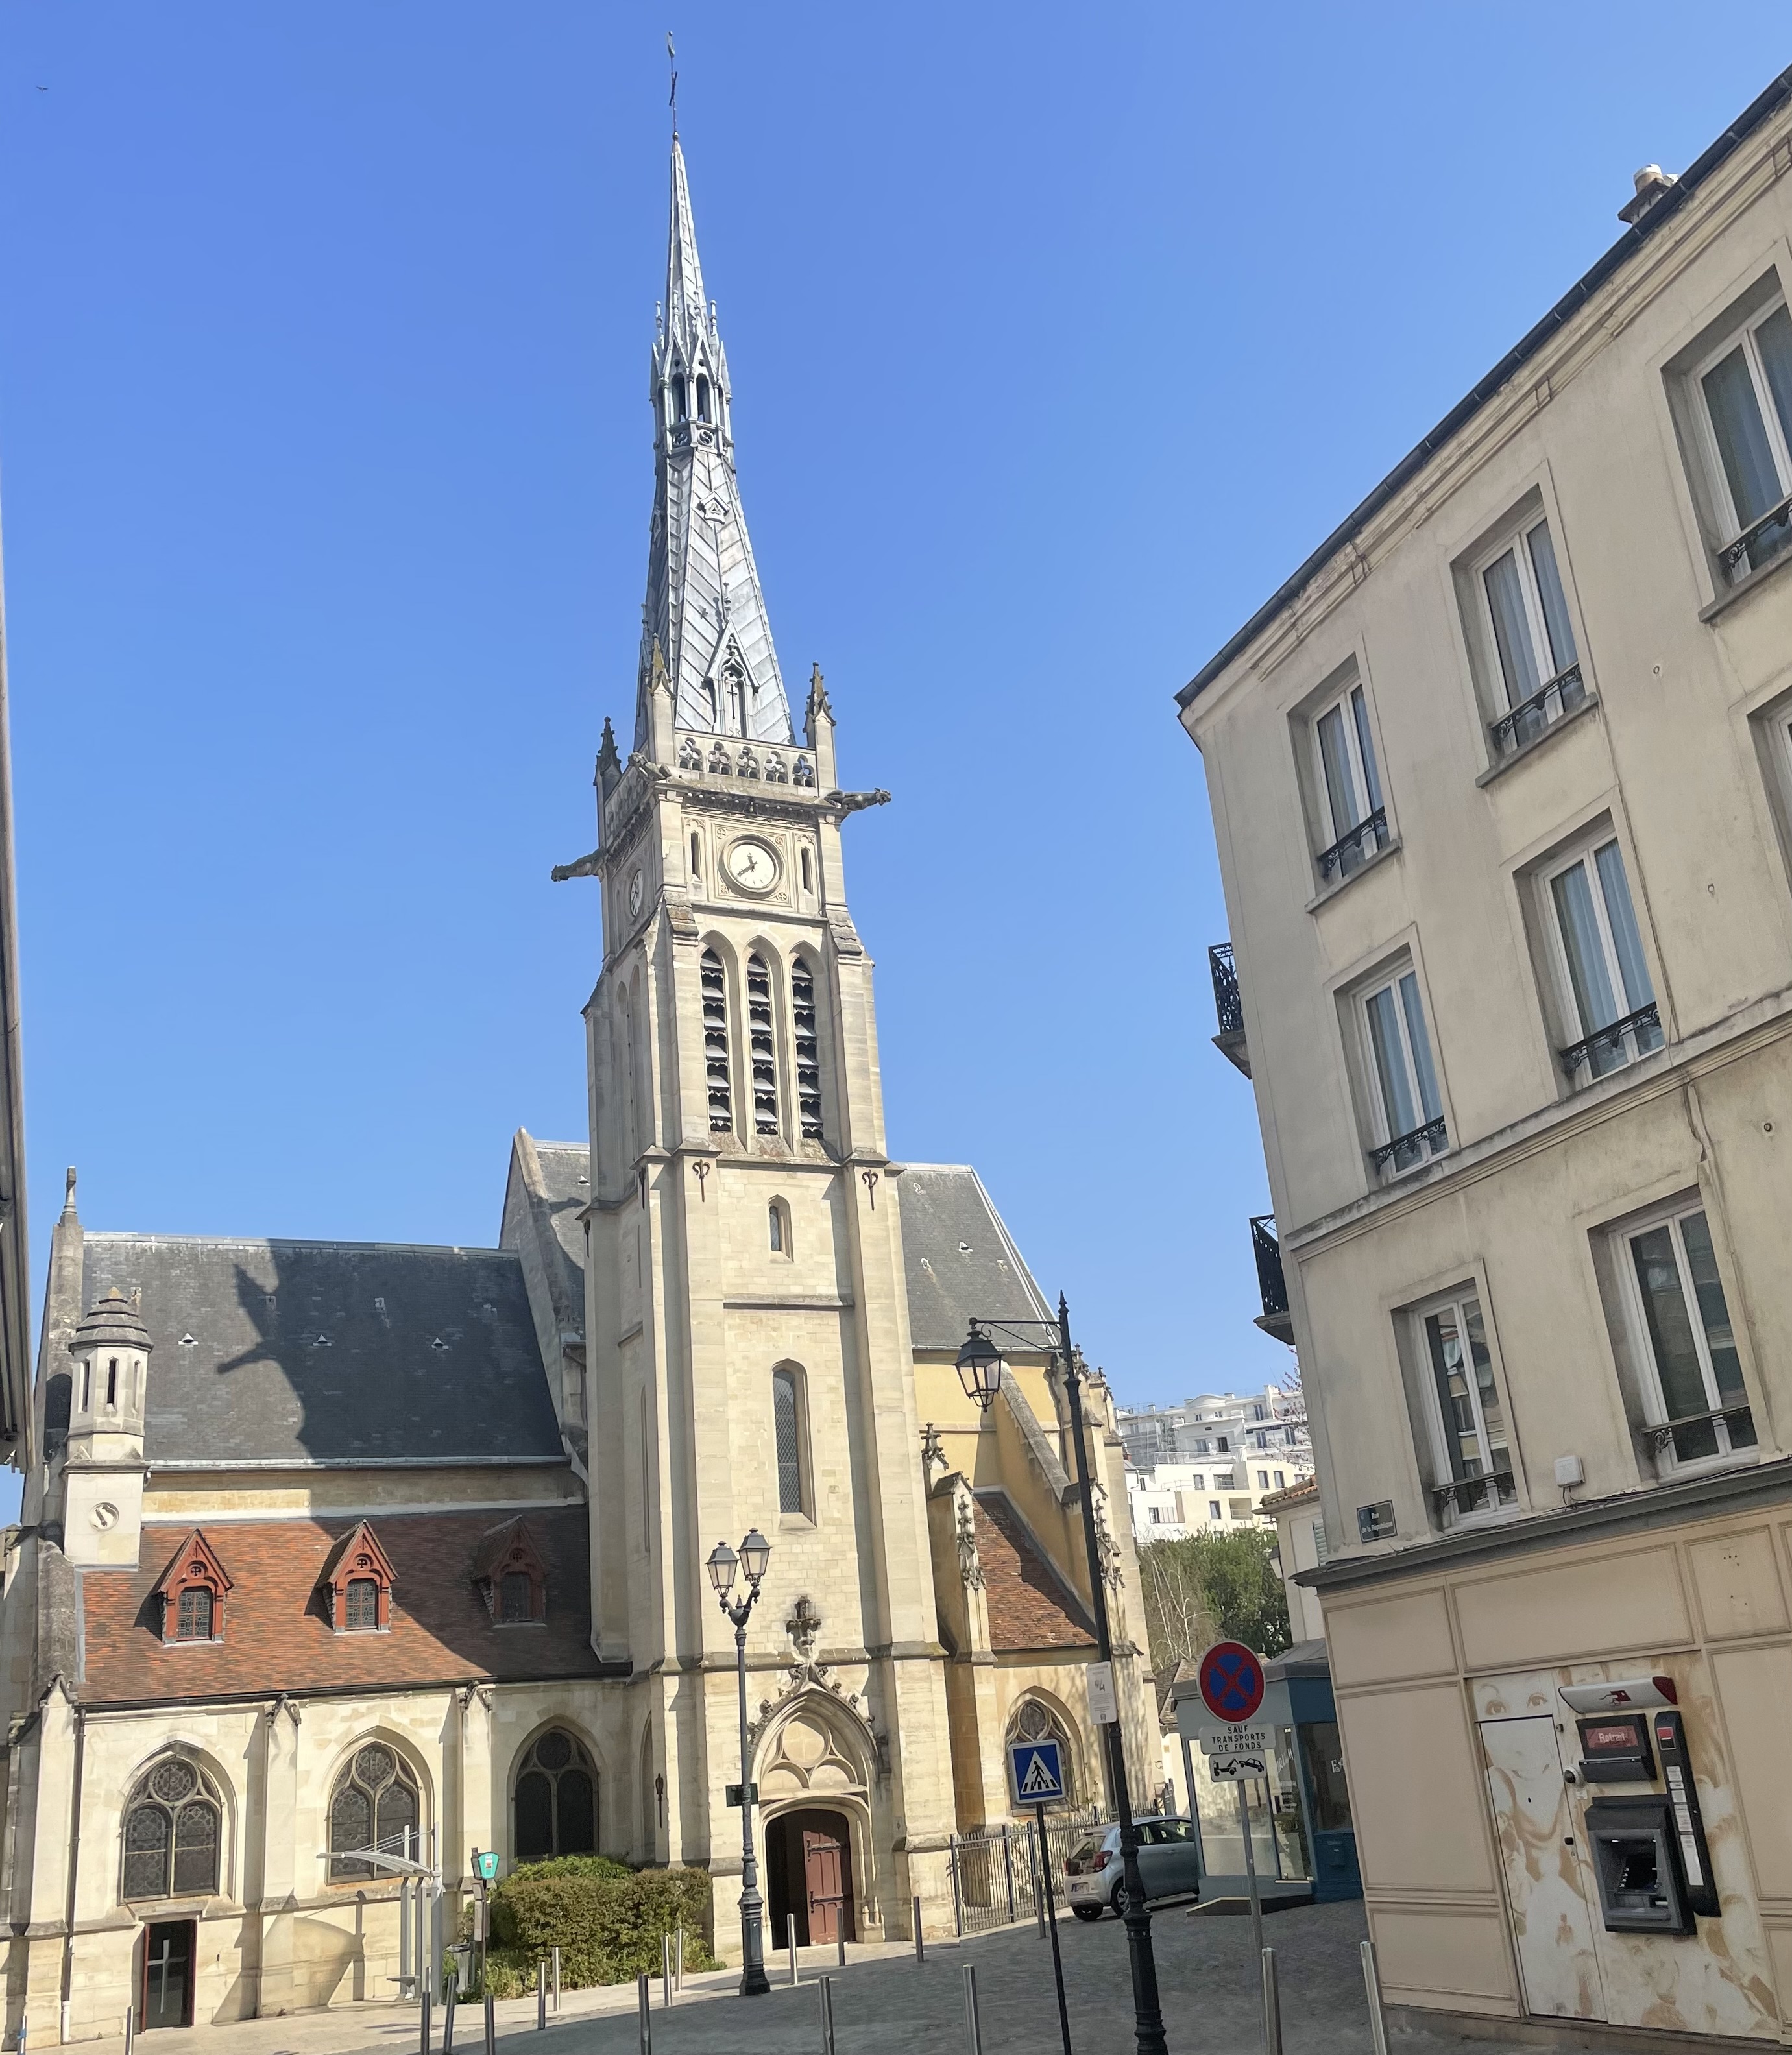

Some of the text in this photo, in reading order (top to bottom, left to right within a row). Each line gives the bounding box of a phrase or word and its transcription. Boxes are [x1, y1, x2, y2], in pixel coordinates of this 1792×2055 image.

[1228, 1725, 1248, 1734] SAUF
[1211, 1733, 1265, 1744] TRANSPORTS
[1598, 1732, 1627, 1744] Retrait
[1218, 1741, 1261, 1752] DE FONDS
